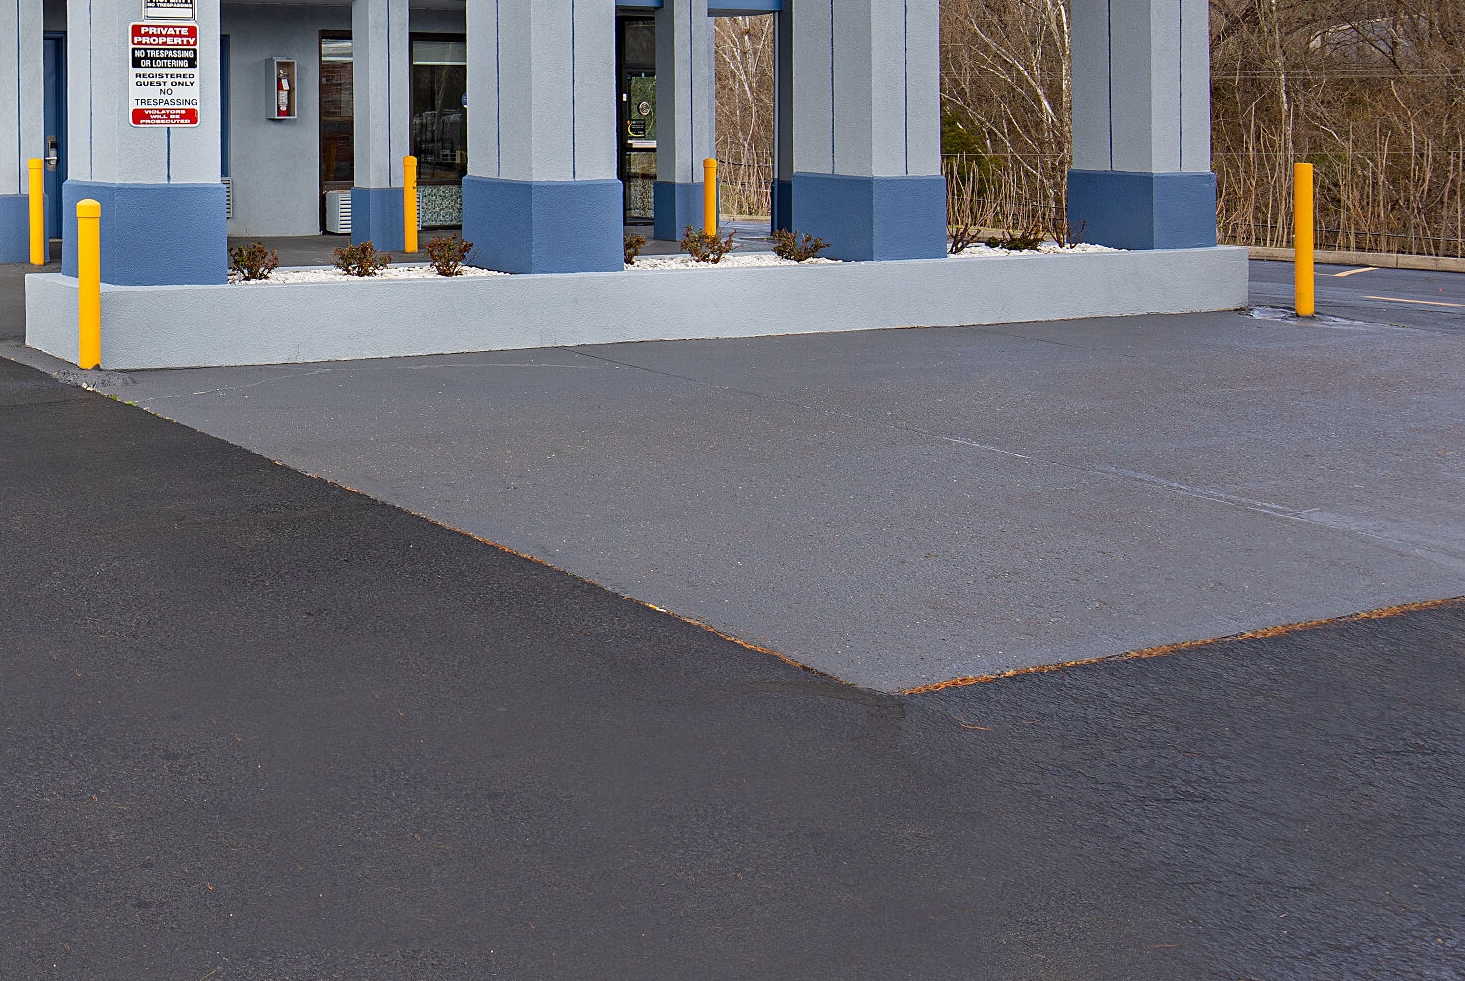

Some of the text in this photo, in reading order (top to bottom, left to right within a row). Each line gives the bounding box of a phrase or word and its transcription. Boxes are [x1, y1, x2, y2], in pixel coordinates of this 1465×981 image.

[140, 26, 189, 35] PRIVATE
[134, 36, 196, 45] PROPERTY
[135, 49, 195, 58] NO TRESPASSING
[140, 59, 189, 68] OR LOITERING
[159, 88, 174, 96] NO
[134, 98, 198, 106] TRESPASSING
